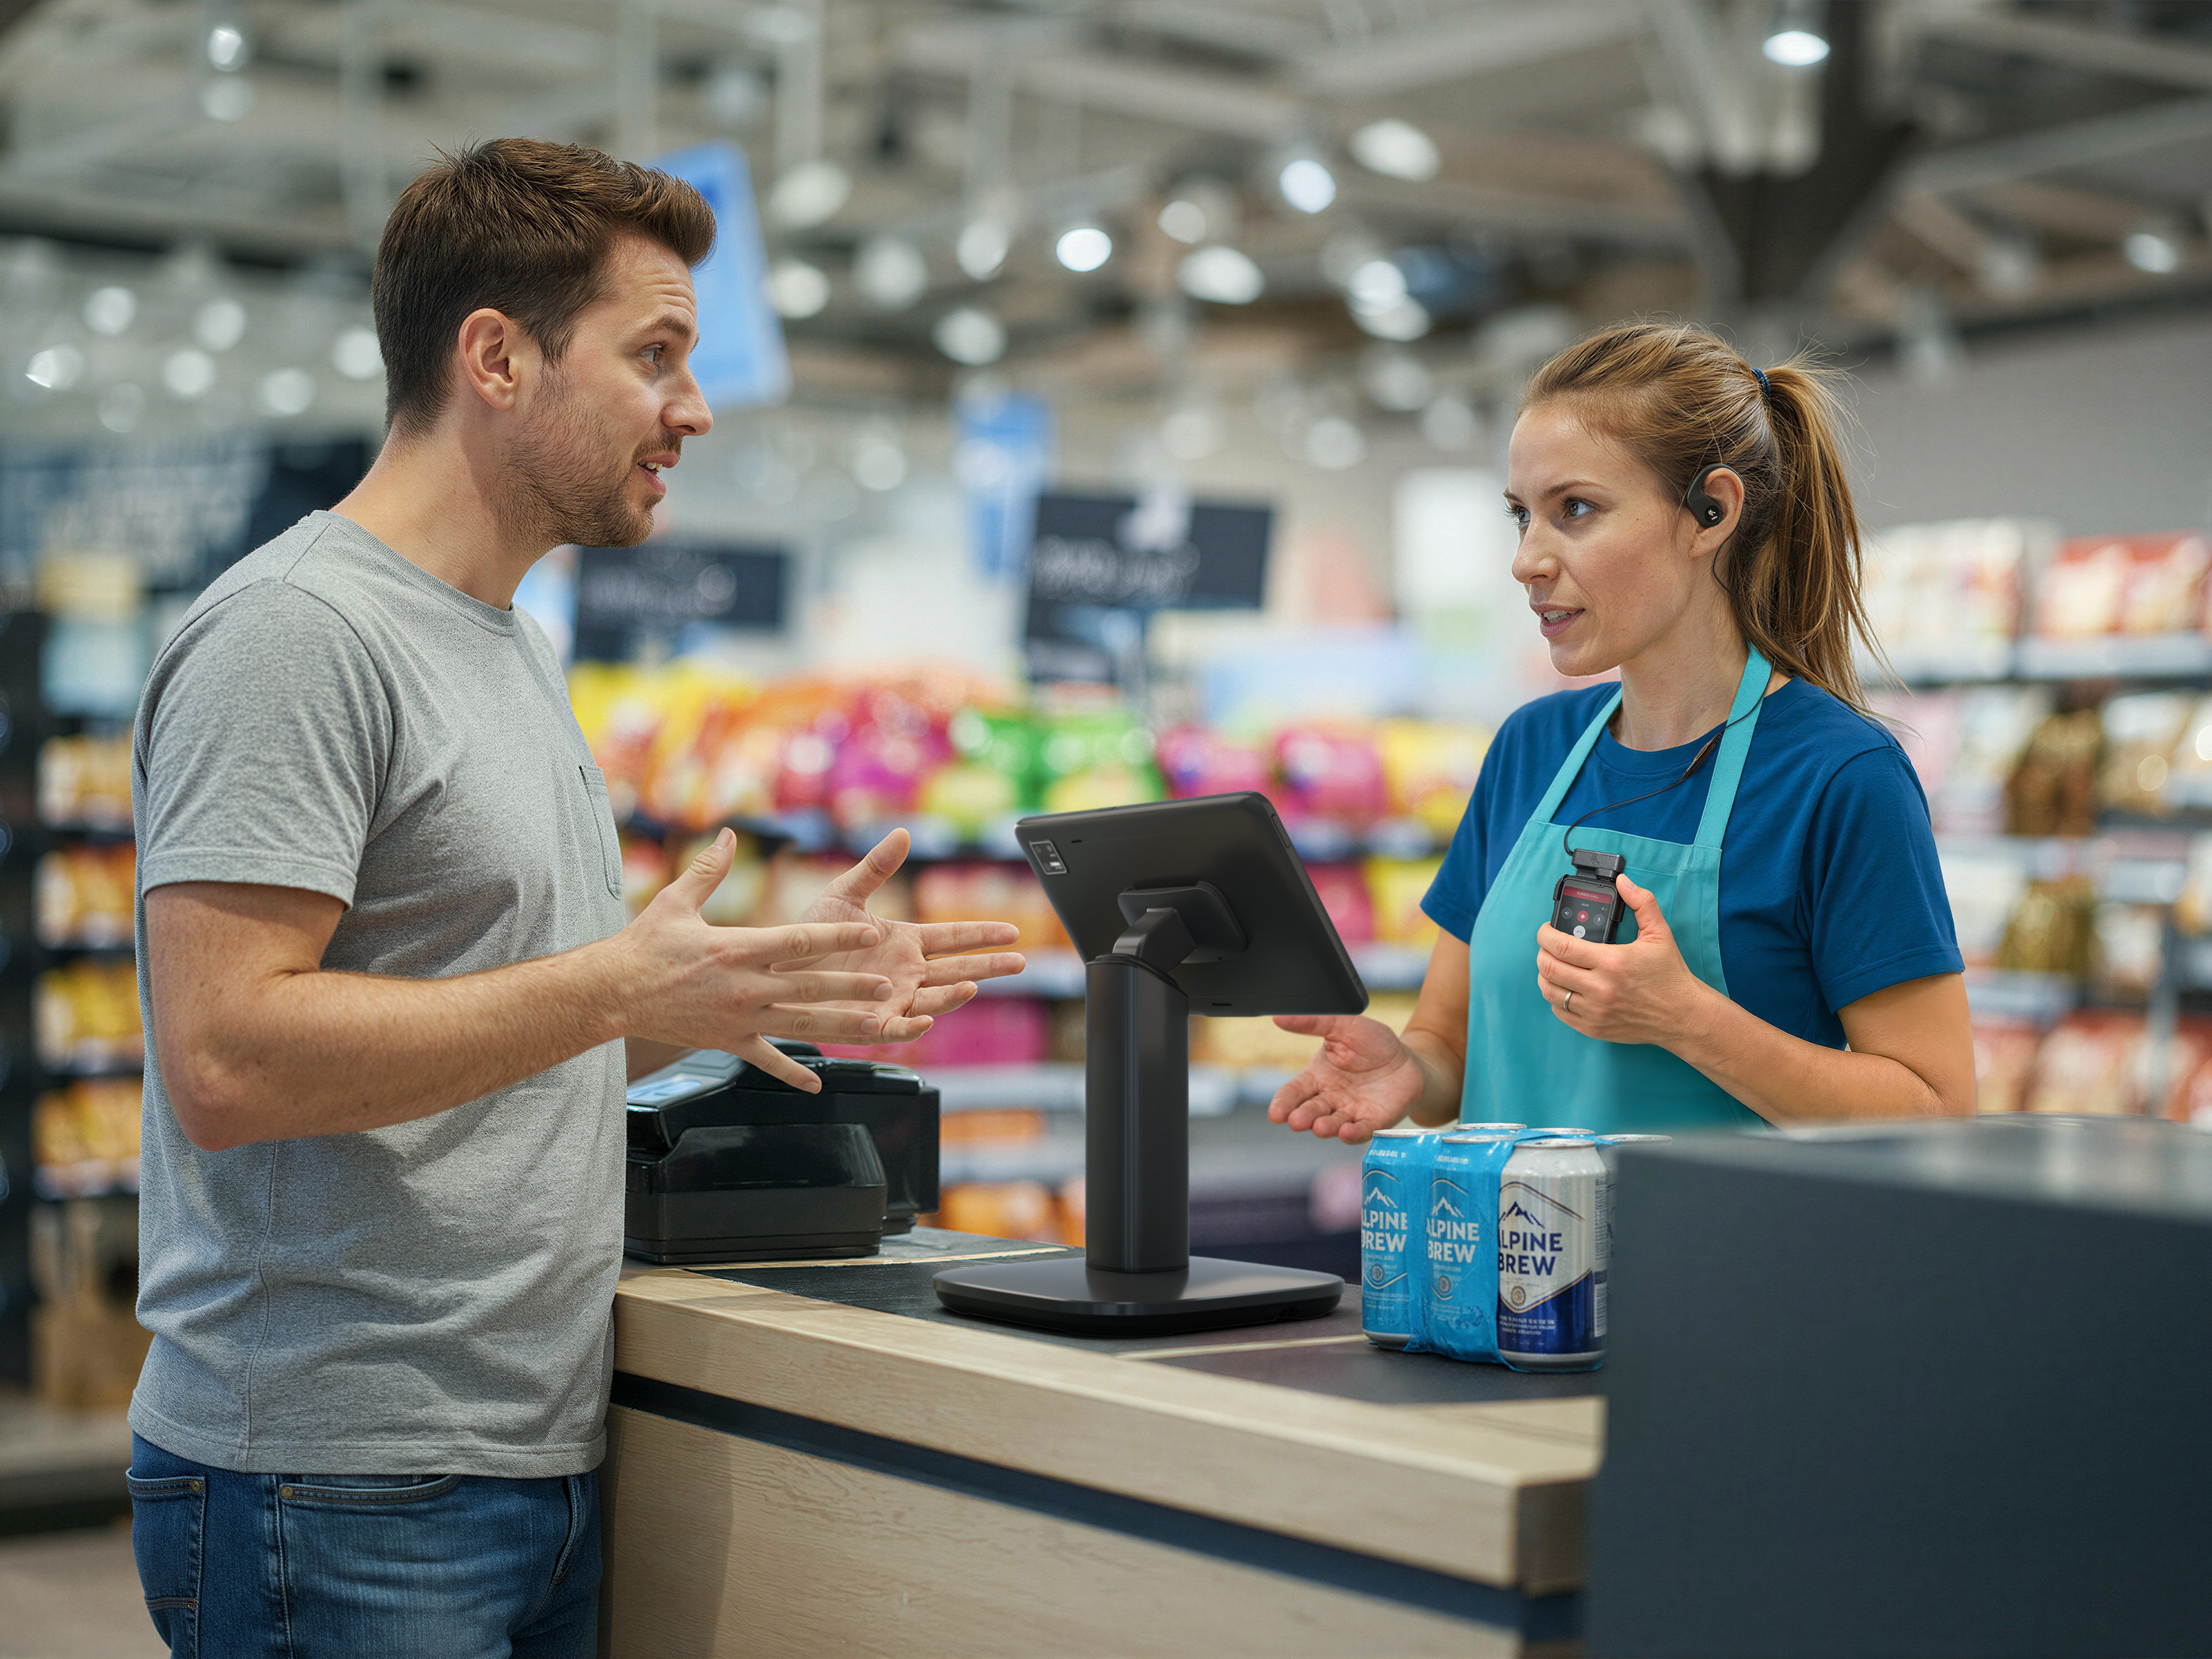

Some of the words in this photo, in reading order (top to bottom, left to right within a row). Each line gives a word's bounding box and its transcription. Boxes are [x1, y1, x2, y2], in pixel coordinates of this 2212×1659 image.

[1362, 1208, 1408, 1230] LPINE
[1428, 1240, 1476, 1263] BREW
[1498, 1230, 1563, 1252] LPINE
[1498, 1252, 1556, 1276] BREW
